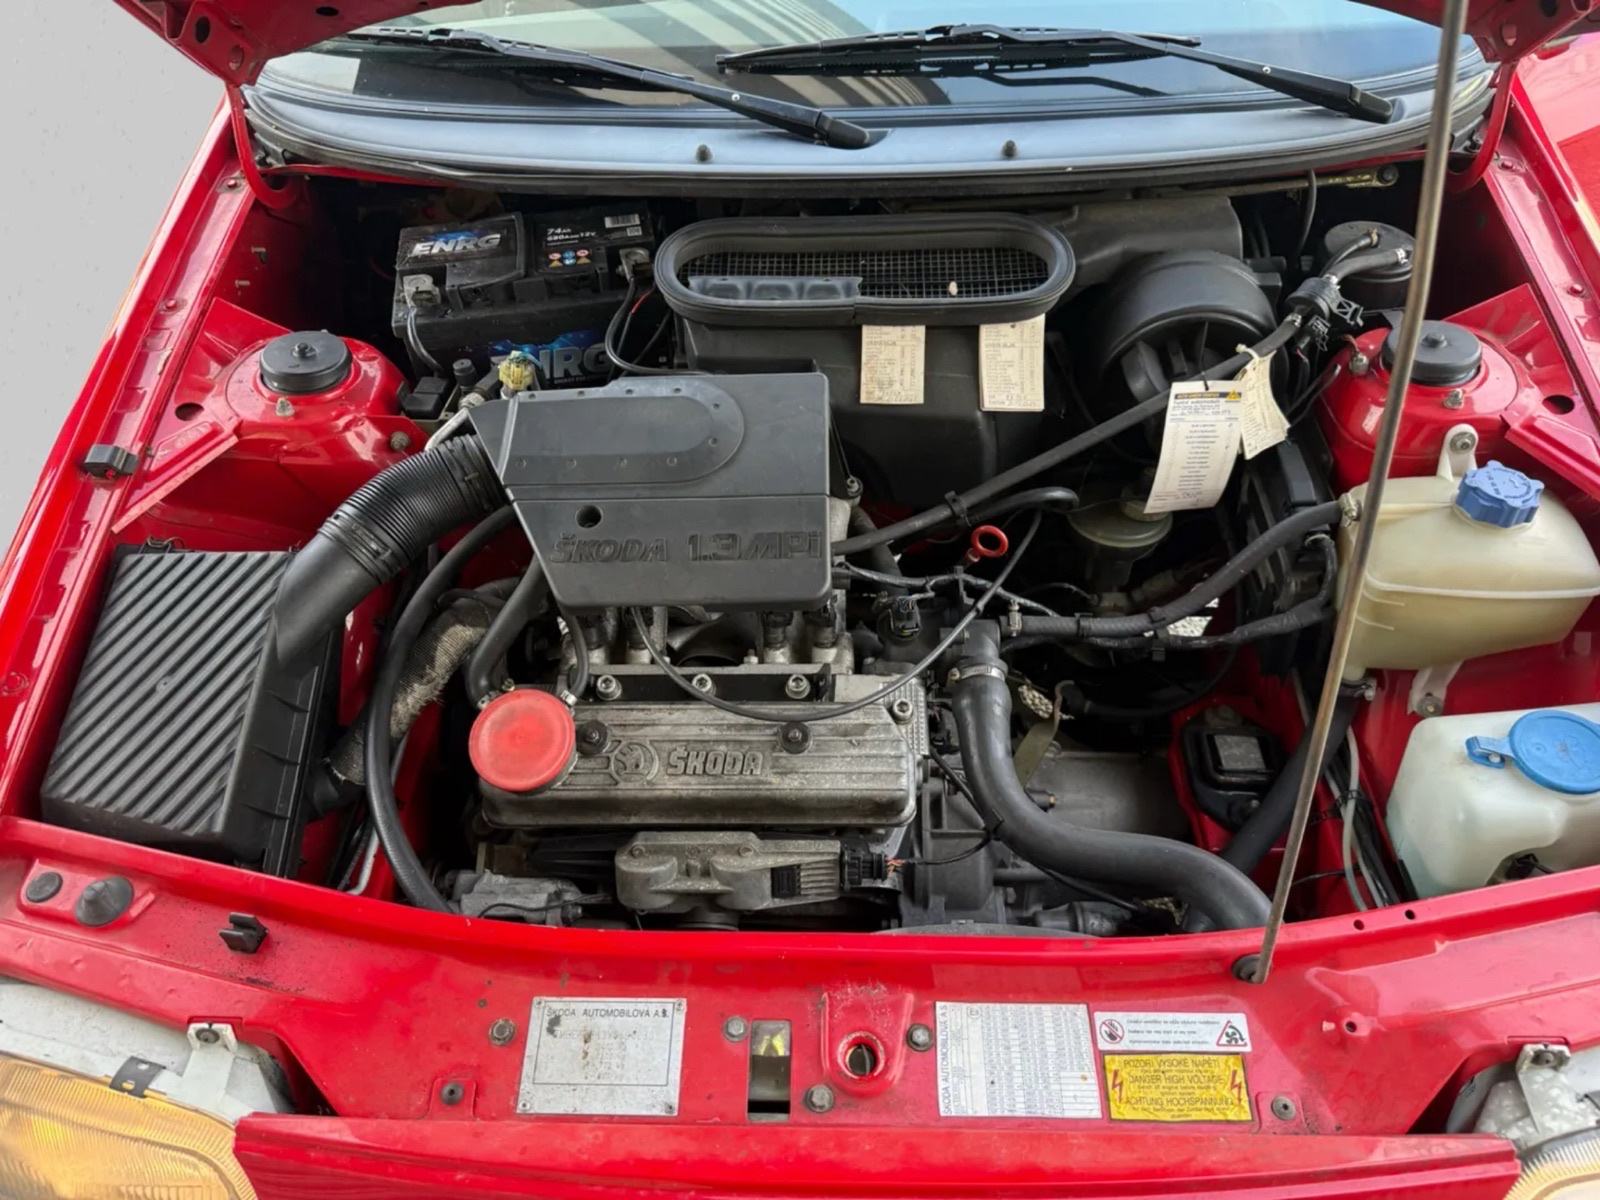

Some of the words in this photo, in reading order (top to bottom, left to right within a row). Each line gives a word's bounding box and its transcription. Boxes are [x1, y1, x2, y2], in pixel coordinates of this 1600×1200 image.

[408, 233, 501, 257] ENRG
[551, 532, 669, 563] ŠKODA
[666, 746, 763, 775] ŠKODA
[1129, 1075, 1161, 1084] DANGER
[1164, 1075, 1184, 1084] HIGH
